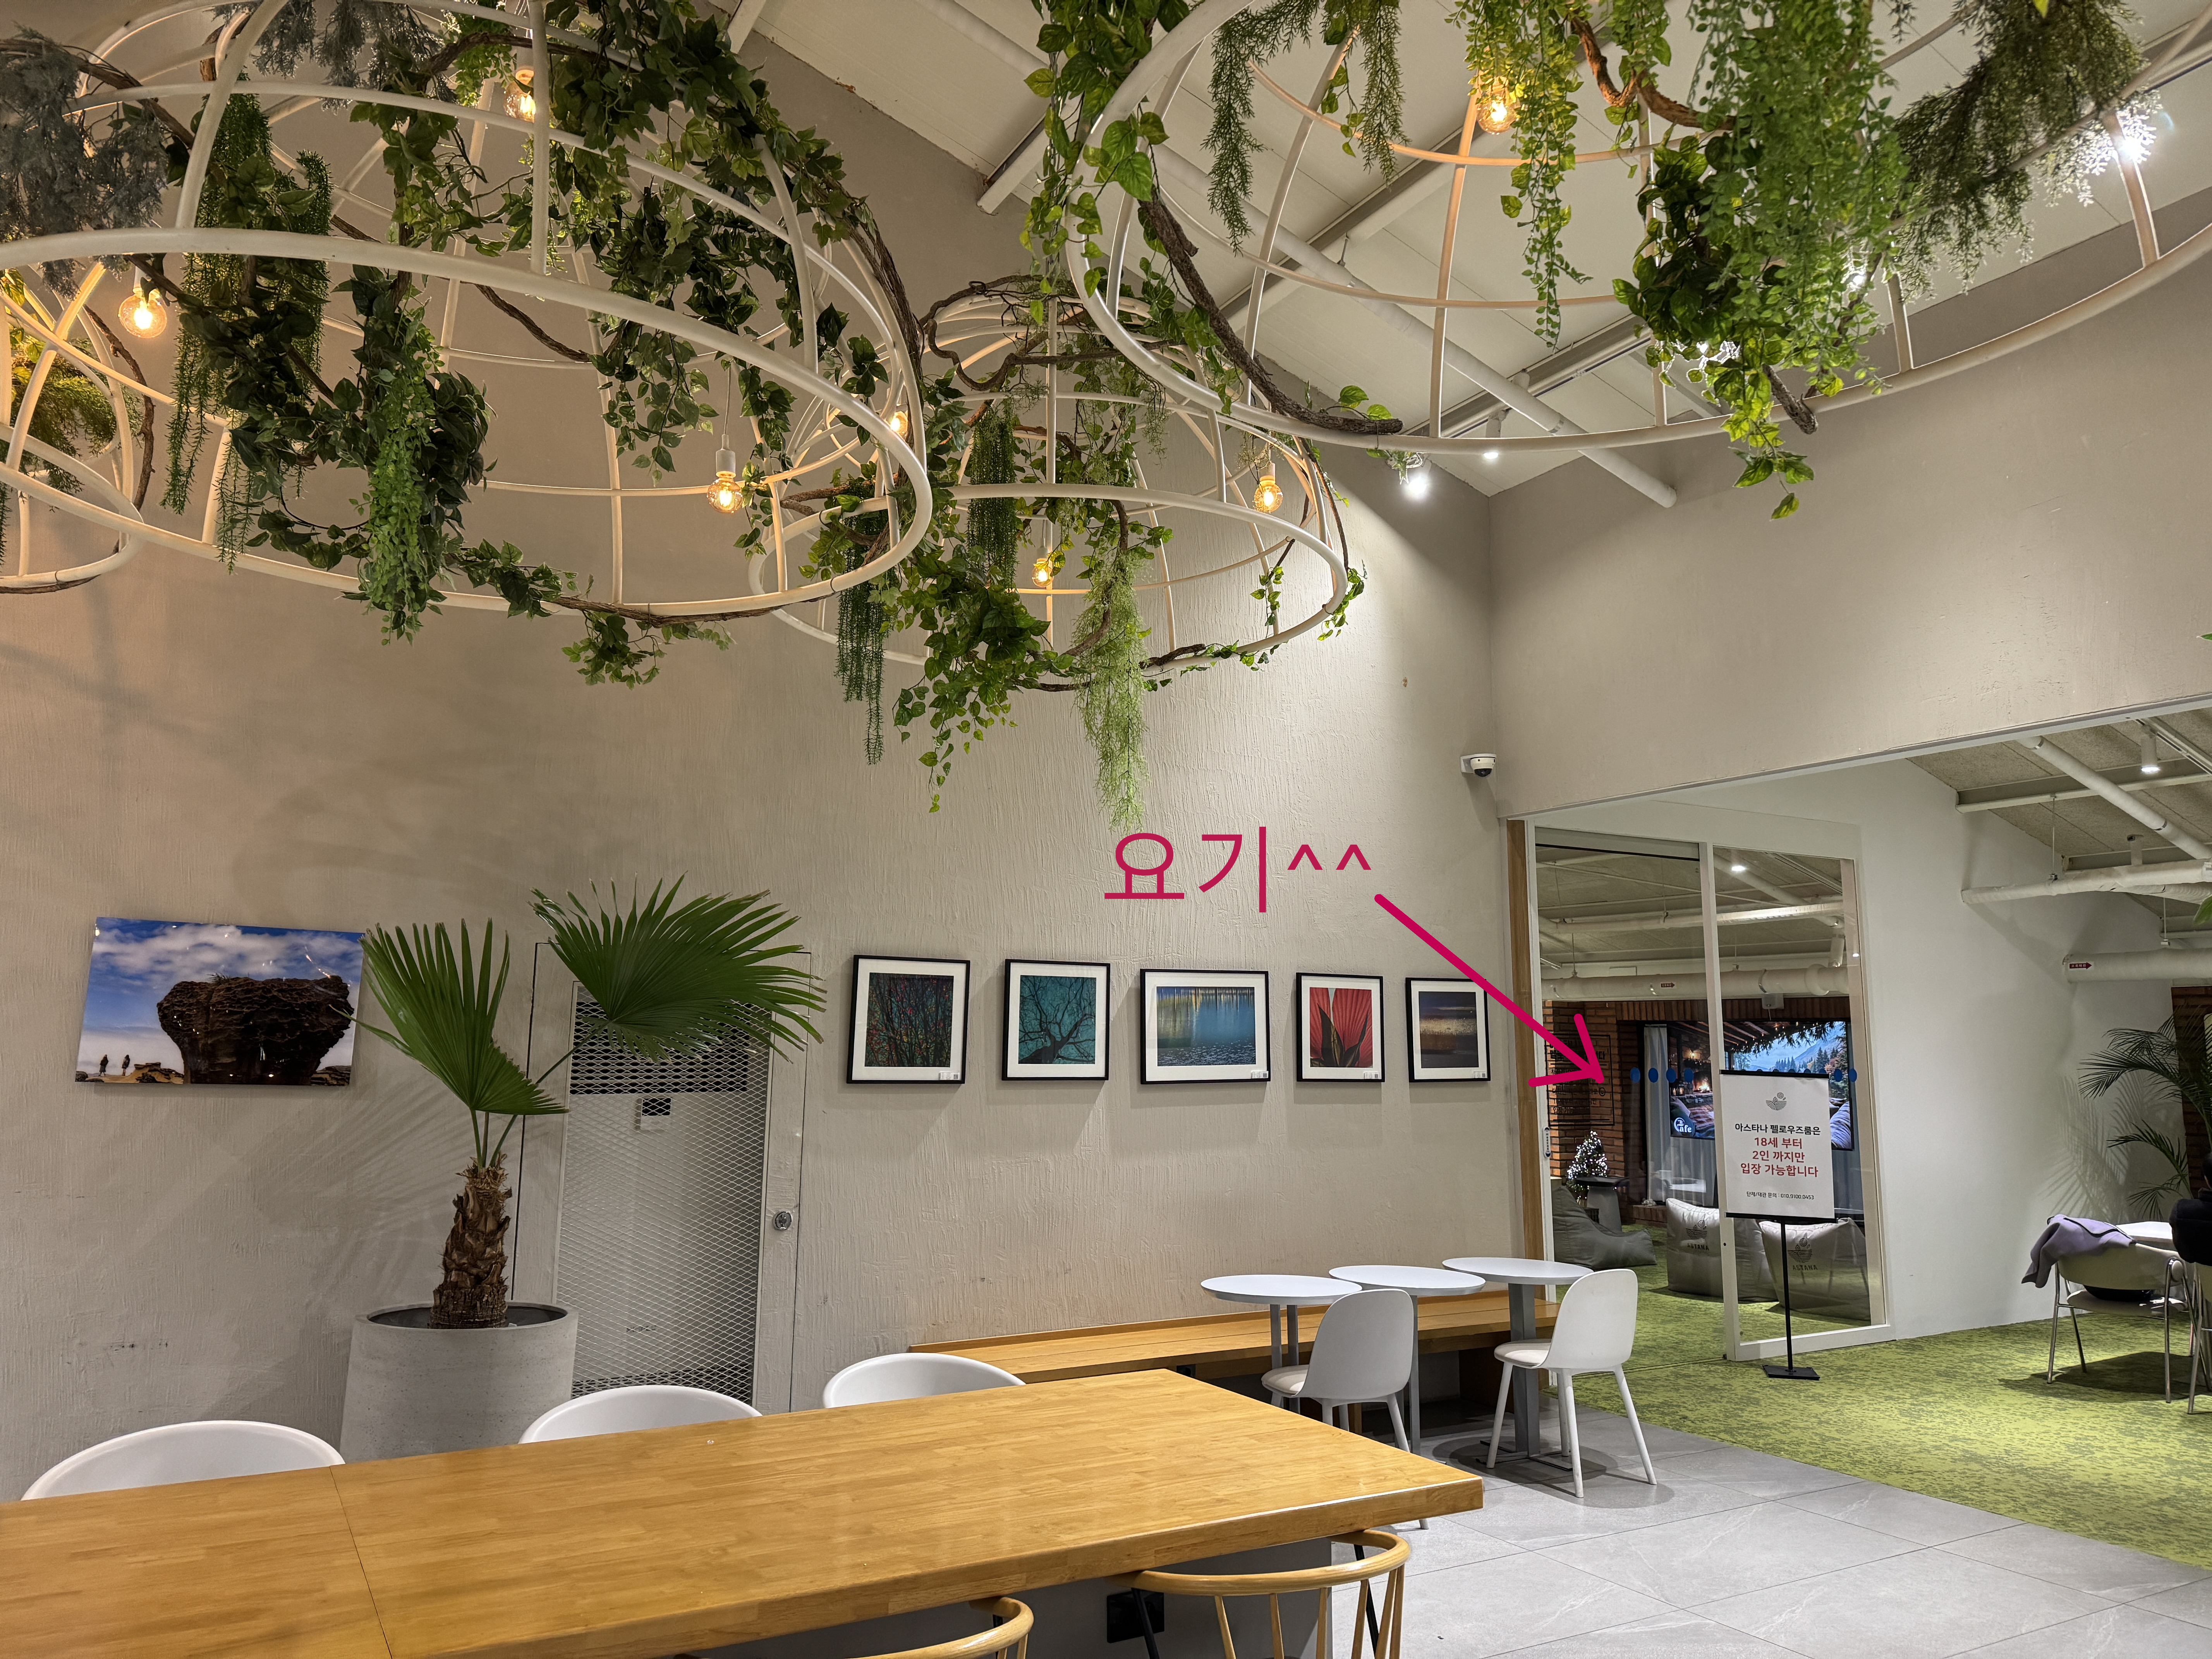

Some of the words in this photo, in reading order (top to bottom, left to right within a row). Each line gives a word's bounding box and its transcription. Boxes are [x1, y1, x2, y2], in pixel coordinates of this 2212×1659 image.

[1735, 1123, 1768, 1133] 아스타나
[1770, 1125, 1821, 1135] 펠로우즈룸은
[1754, 1137, 1778, 1148] 18세
[1781, 1138, 1802, 1149] 부터
[1752, 1150, 1769, 1161] 2인
[1772, 1151, 1805, 1163] 까지만
[1740, 1163, 1761, 1175] 입장
[1764, 1164, 1819, 1177] 가능합니다
